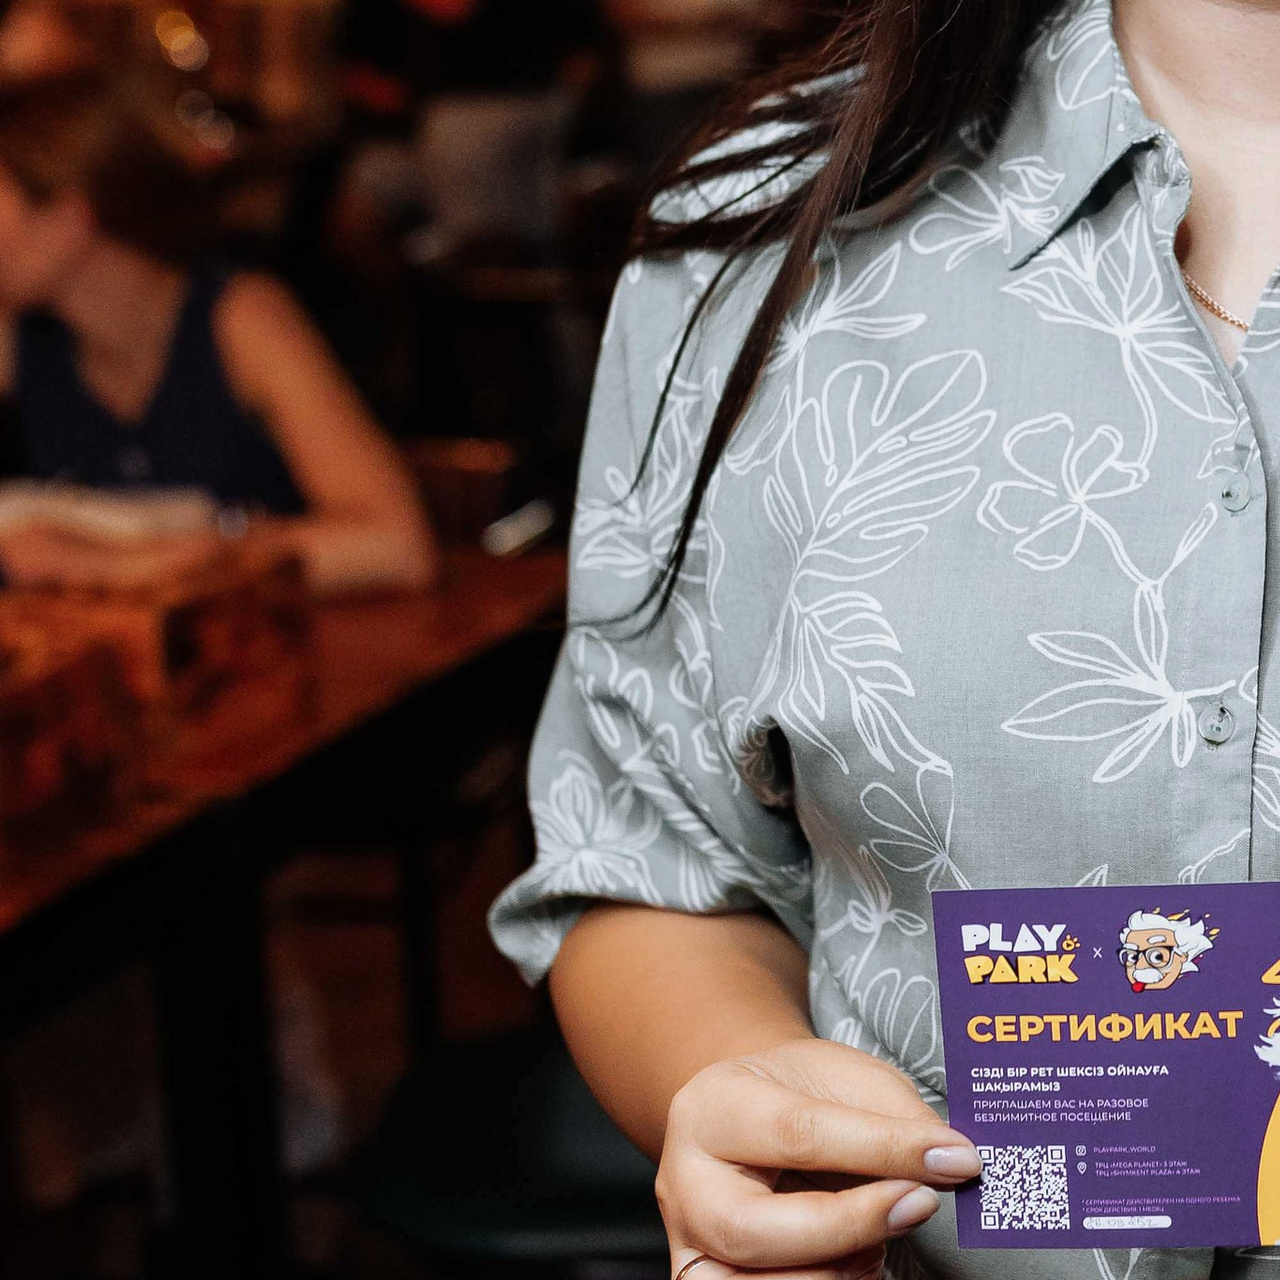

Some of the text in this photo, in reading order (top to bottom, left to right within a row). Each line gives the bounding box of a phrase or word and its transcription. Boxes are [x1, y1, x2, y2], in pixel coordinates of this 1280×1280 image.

[961, 923, 1067, 952] PLAY
[964, 954, 1079, 984] PARK
[966, 1010, 1244, 1043] СЕРТИФИКАТ
[971, 1064, 1169, 1079] СІЗДІ БІР РЕТ ШЕКСІЗ ОЙНАУҒА
[972, 1081, 1060, 1093] ШАҚЫРАМЫЗ
[973, 1098, 1149, 1109] ПРИГЛАШАЕМ ВАС НА РАЗОВОЕ
[974, 1111, 1131, 1122] БЕЗЛИМИТНОЕ ПОСЕЩЕНИЕ
